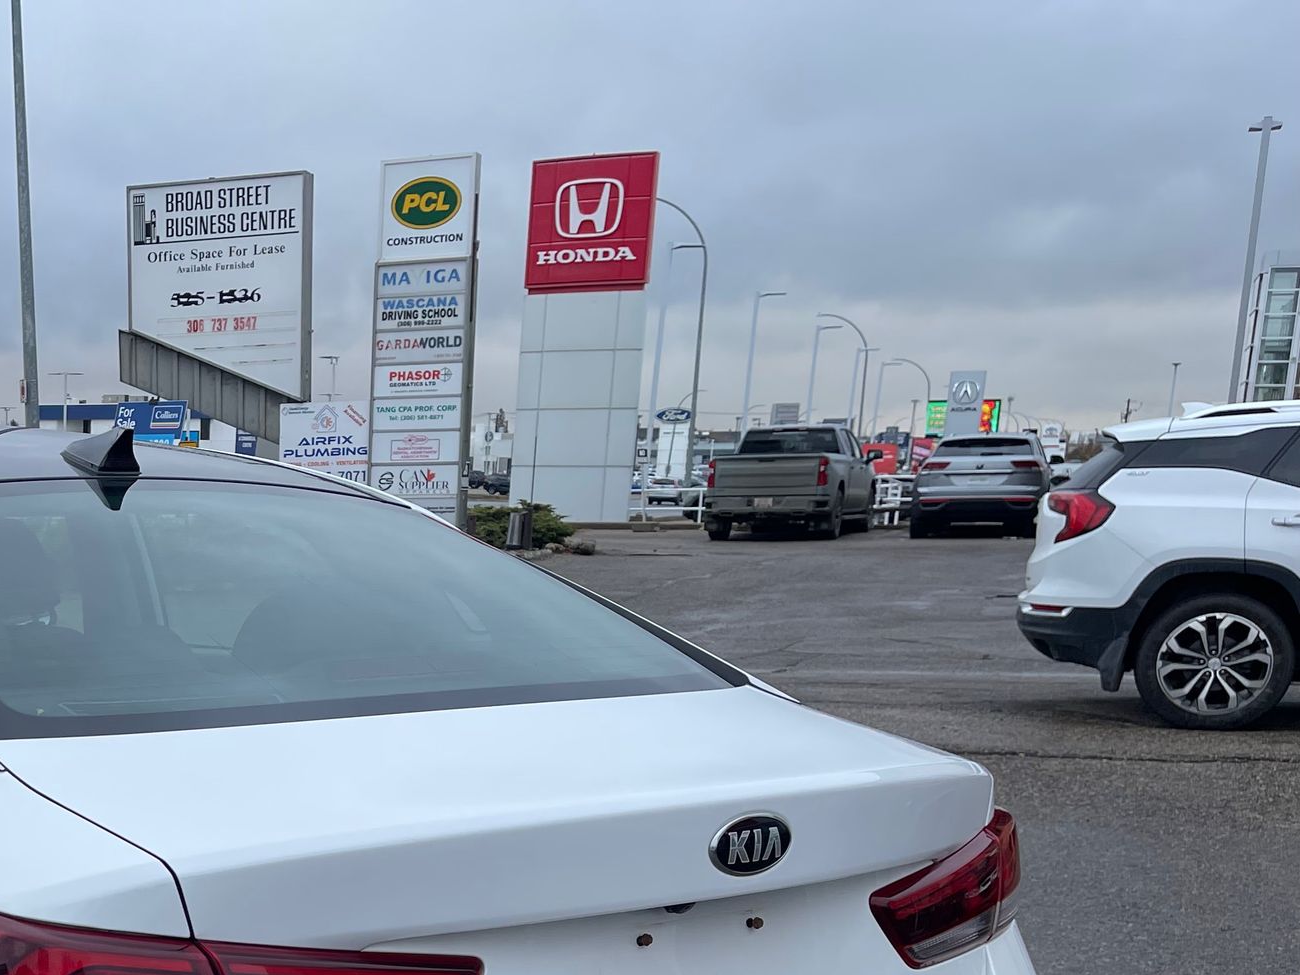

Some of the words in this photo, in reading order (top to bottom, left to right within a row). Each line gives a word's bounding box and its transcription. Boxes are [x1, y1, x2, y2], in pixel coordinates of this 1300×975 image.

[165, 190, 213, 213] BROAD
[218, 185, 271, 208] STREET
[402, 191, 451, 215] PCL
[166, 212, 236, 238] BUSINESS
[240, 208, 296, 232] CENTRE
[386, 233, 464, 246] CONSTRUCTION
[147, 250, 186, 263] Office
[190, 248, 223, 262] Space
[229, 246, 248, 258] For
[254, 244, 286, 255] Lease
[536, 246, 637, 265] HONDA
[177, 264, 212, 274] Available
[215, 260, 255, 271] Furnished
[382, 296, 459, 310] WASCANA
[382, 309, 419, 321] DRIVING
[421, 307, 458, 318] SCHOOL
[187, 319, 205, 333] 306
[211, 317, 228, 332] 737
[233, 316, 258, 331] 3547
[389, 370, 441, 381] PHASOR
[118, 406, 135, 418] For
[154, 410, 179, 420] Colliers
[662, 409, 688, 421] Ford
[116, 417, 136, 429] Sale
[298, 435, 353, 446] AIRFIX
[283, 446, 368, 458] PLUMBING
[398, 481, 449, 490] SUPPLIER
[728, 826, 782, 865] KIA
